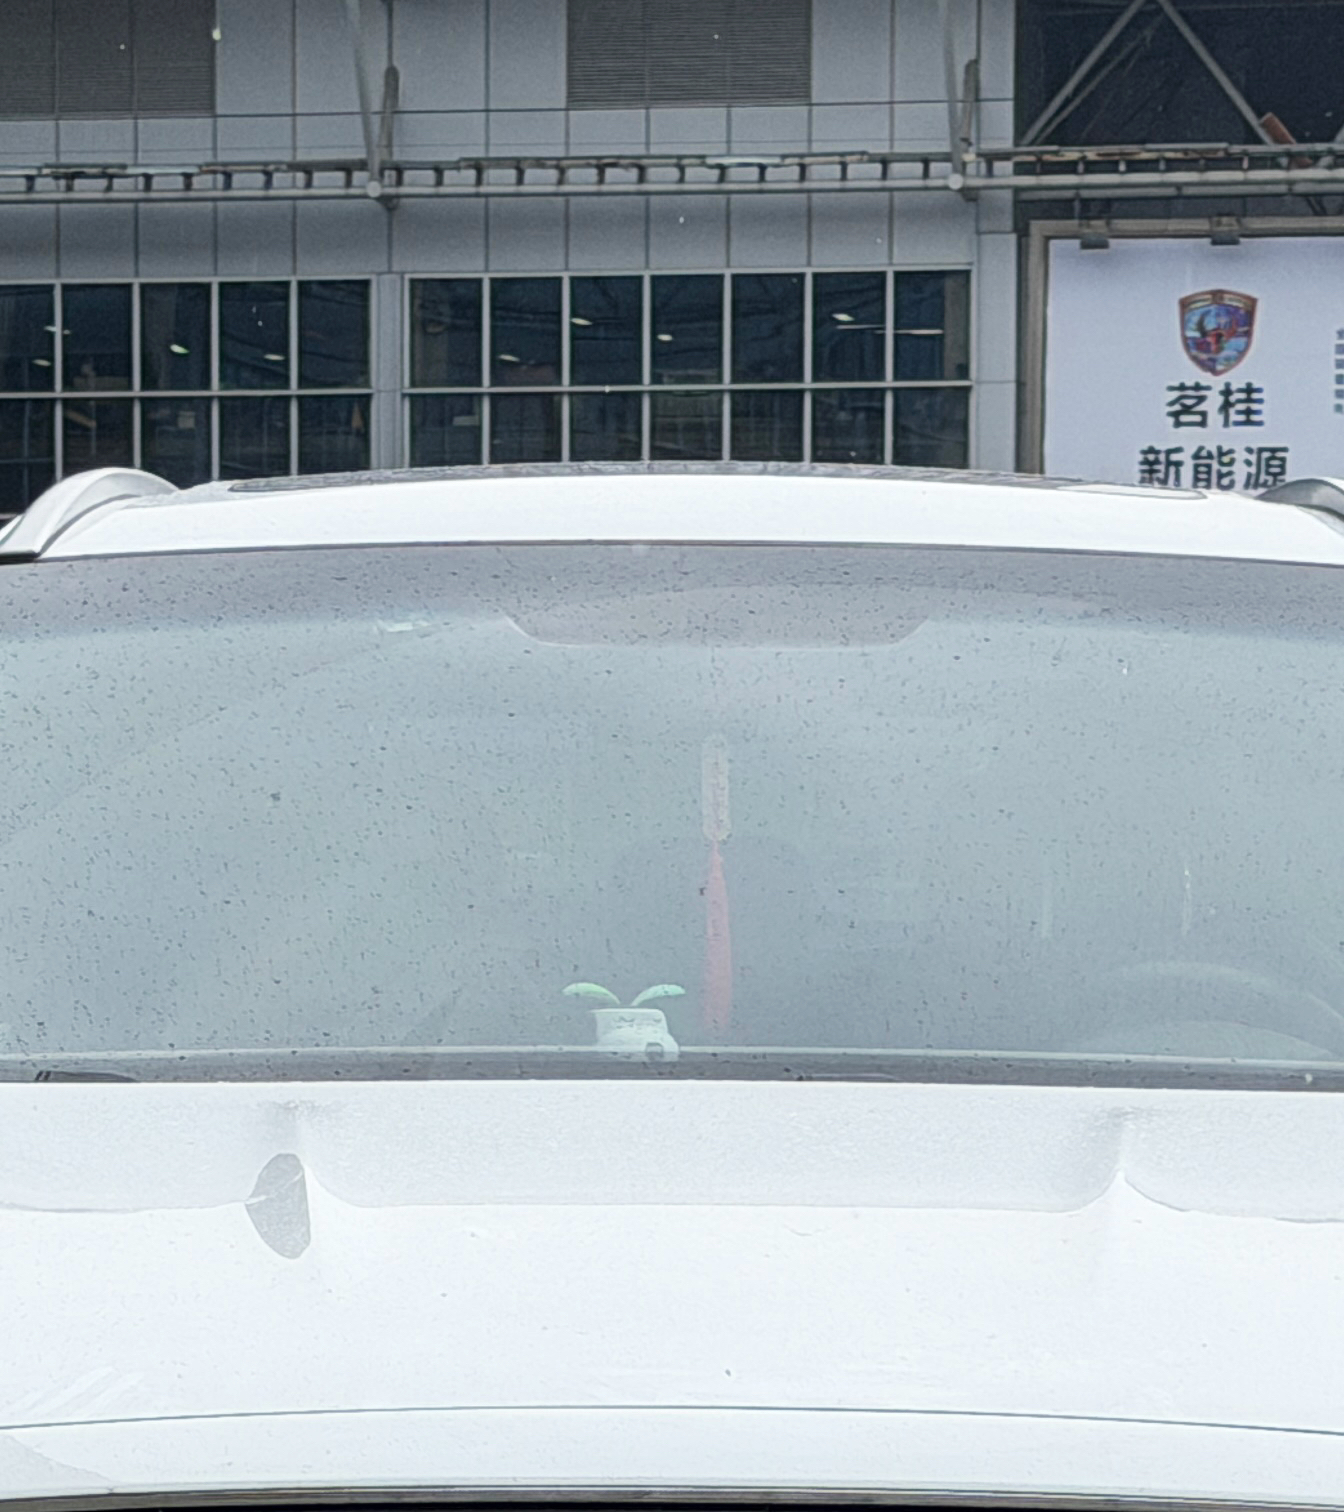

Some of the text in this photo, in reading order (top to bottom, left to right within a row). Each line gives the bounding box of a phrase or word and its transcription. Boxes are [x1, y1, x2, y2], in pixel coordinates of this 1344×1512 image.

[1166, 382, 1264, 428] 茗桂
[1139, 445, 1289, 490] 新能源
